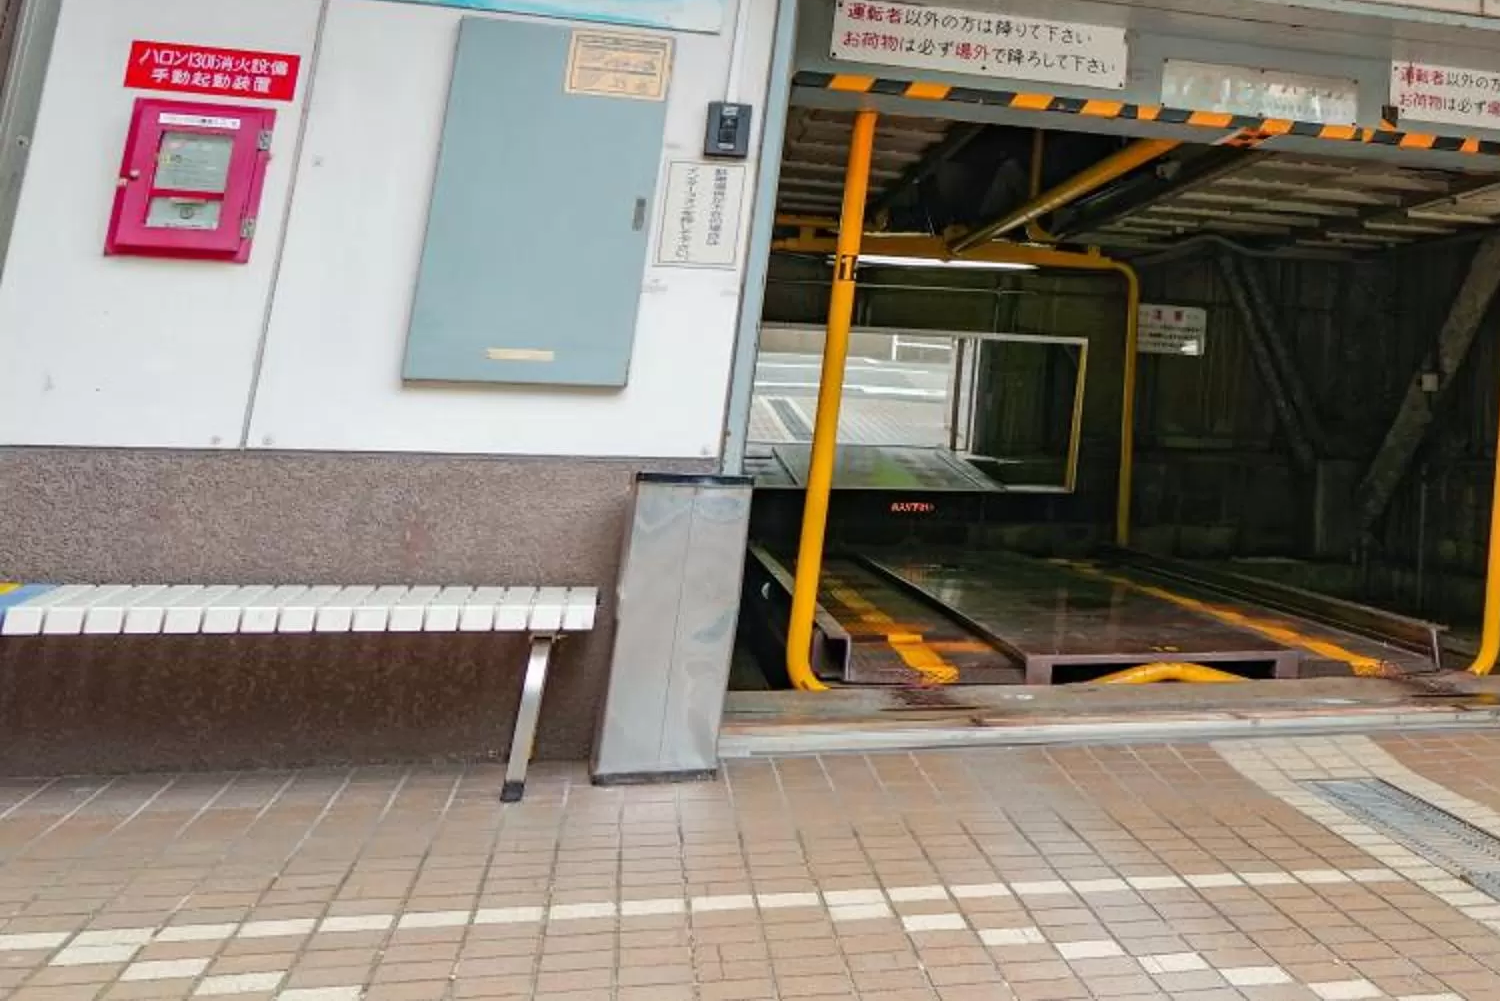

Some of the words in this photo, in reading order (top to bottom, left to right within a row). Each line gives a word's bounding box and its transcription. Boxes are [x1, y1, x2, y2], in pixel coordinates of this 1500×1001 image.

[847, 3, 1092, 45] 運転者以外の方は降りて下さい
[139, 48, 289, 76] ハロン1301消火設備
[842, 31, 1116, 74] お荷物は必ず場外で降ろして下さい
[152, 67, 272, 93] 手動起動装置
